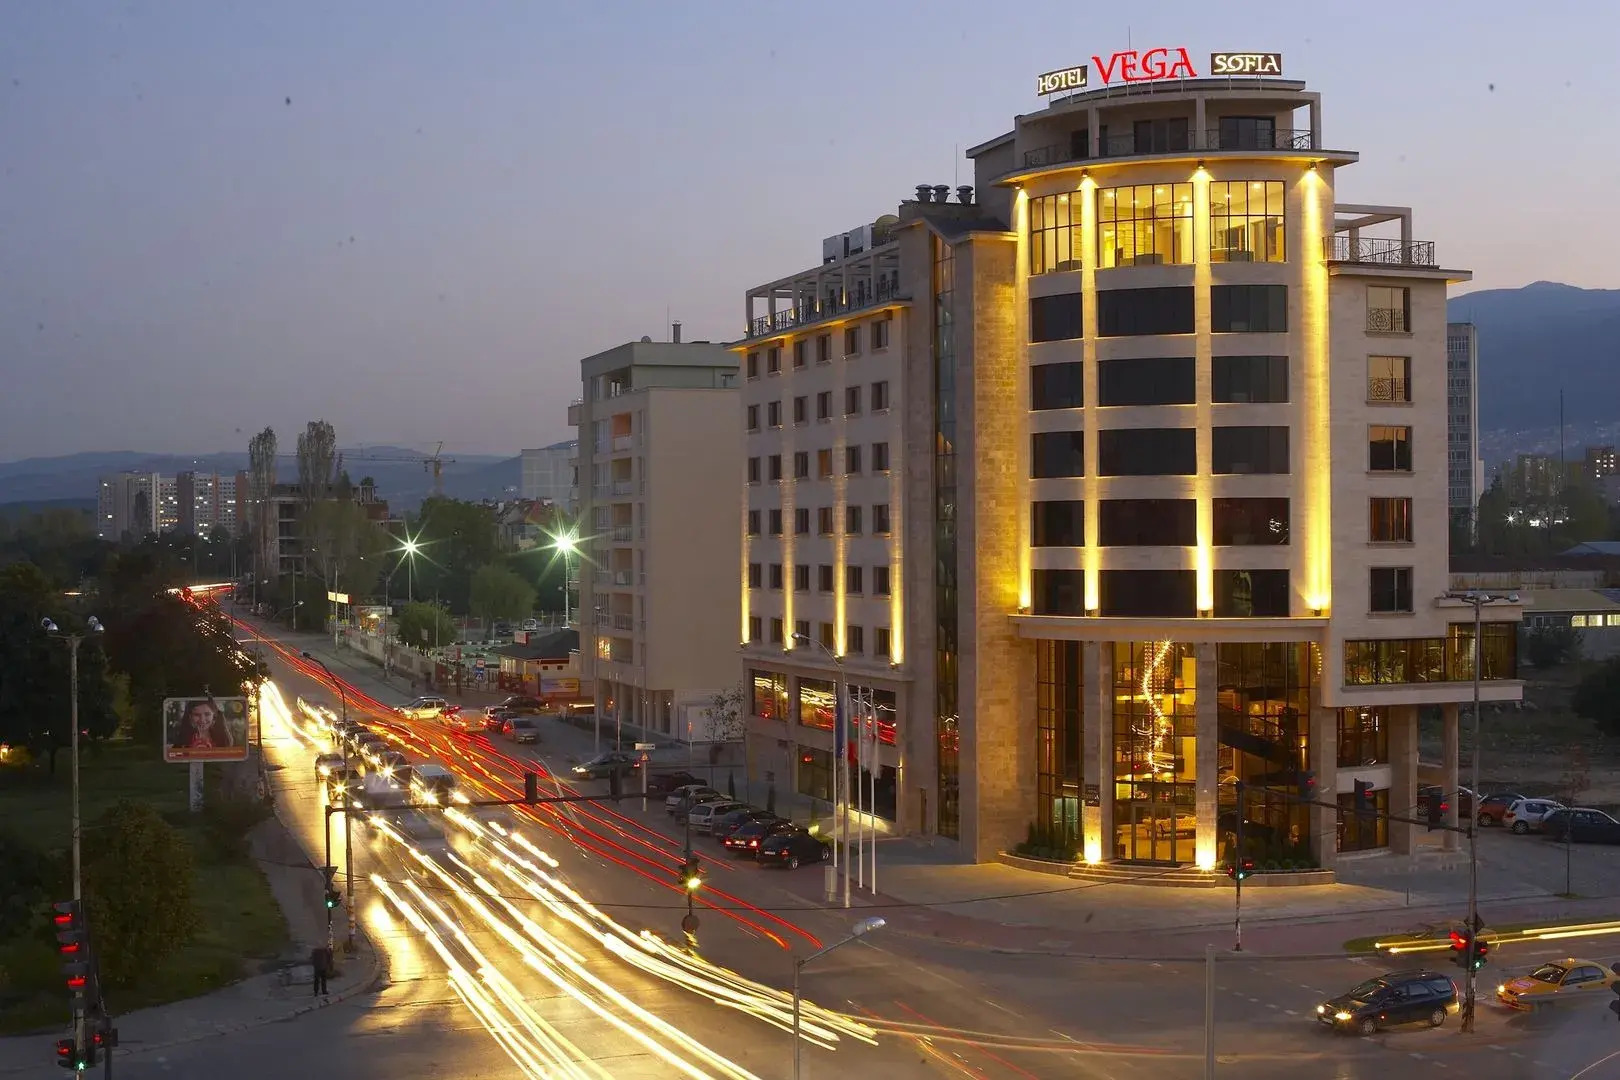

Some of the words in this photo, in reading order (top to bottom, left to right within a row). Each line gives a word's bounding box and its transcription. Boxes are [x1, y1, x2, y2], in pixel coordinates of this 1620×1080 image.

[1038, 68, 1086, 93] HOTEL
[1091, 47, 1198, 84] VEGA
[1213, 54, 1281, 73] SOFIA
